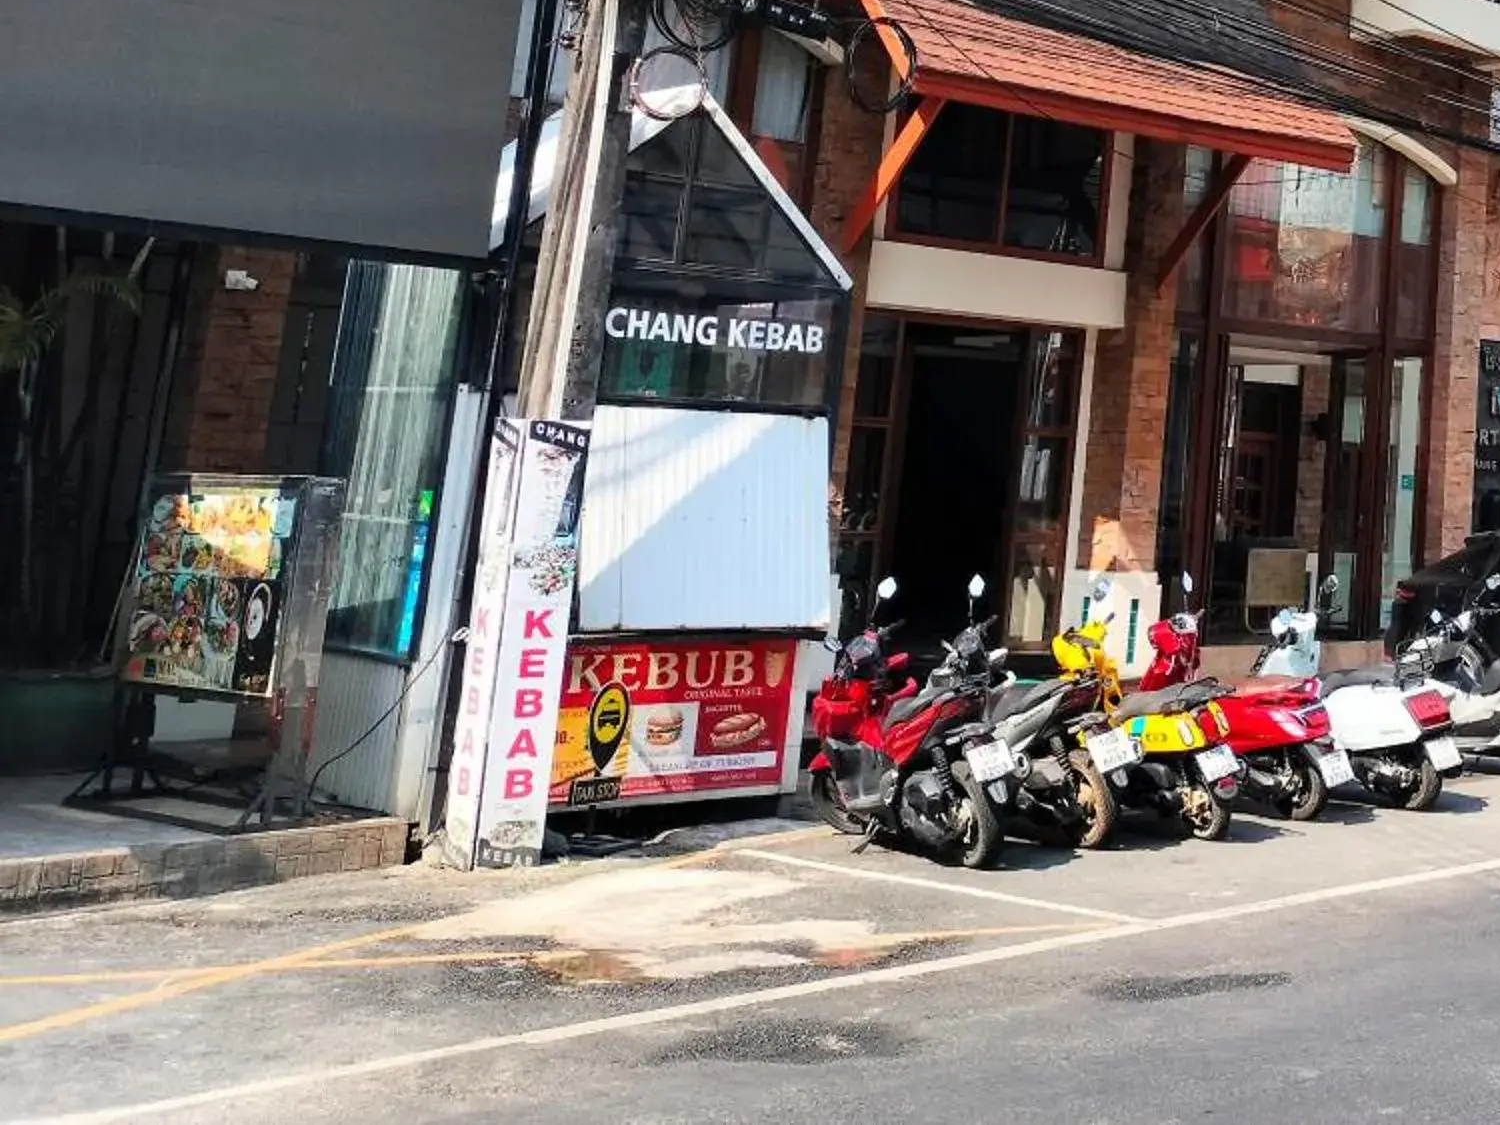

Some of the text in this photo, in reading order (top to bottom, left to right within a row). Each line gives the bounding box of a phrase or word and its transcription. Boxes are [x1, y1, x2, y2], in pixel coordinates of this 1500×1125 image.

[605, 307, 823, 353] CHANG KEBAB
[535, 423, 586, 447] CHANG
[567, 650, 754, 694] KEBUB
[504, 610, 553, 799] KEBAB
